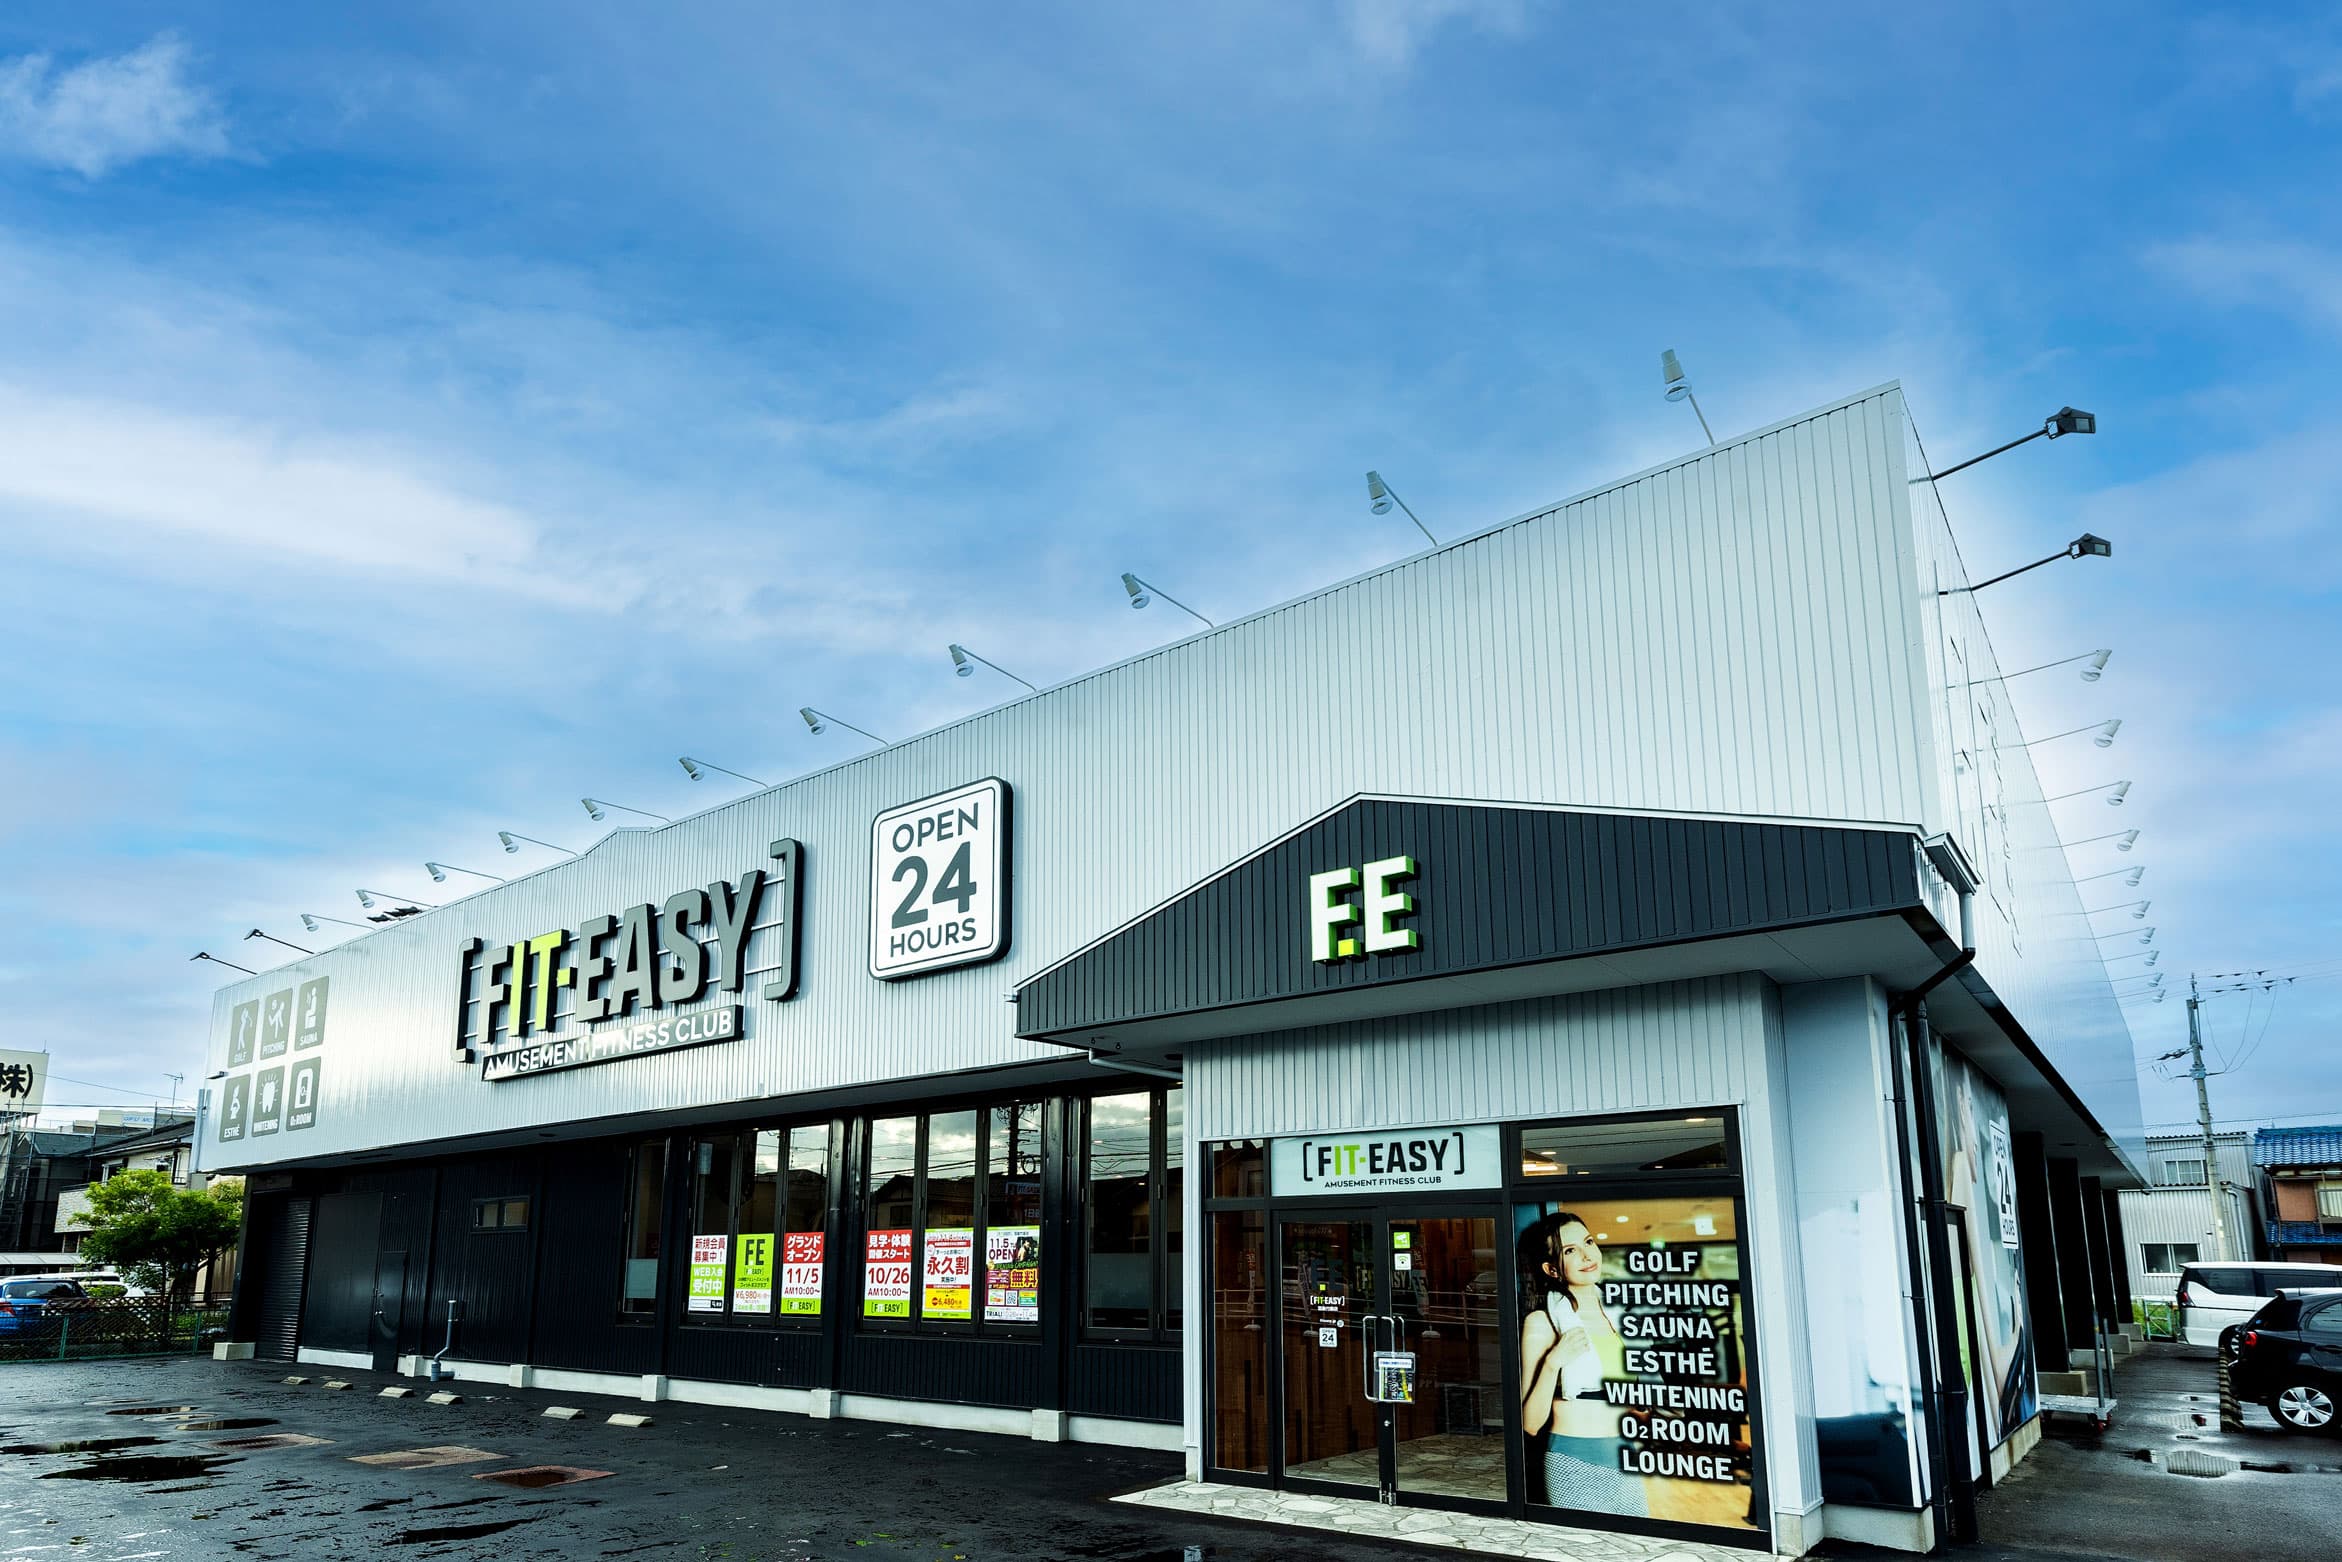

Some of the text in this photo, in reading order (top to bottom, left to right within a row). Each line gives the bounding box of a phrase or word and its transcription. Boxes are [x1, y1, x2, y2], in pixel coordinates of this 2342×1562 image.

[891, 802, 978, 853] OPEN
[891, 841, 978, 929] 24
[889, 916, 977, 959] HOURS
[485, 1008, 733, 1080] AMUSEMENT FITNESS CLUB
[1324, 1176, 1442, 1188] AMUSEMENT FITNESS CLUB
[1997, 1161, 2012, 1215] 24
[787, 1235, 822, 1249] グランド
[786, 1248, 821, 1262] オープン
[927, 1255, 970, 1275] 永久割
[1629, 1250, 1698, 1273] GOLF
[693, 1279, 722, 1294] 受付中
[787, 1268, 819, 1285] 11/5
[868, 1267, 910, 1285] 10/26
[1011, 1269, 1037, 1287] 無料
[1605, 1281, 1730, 1307] PITCHING
[1322, 1333, 1334, 1342] 24
[1623, 1315, 1714, 1339] SAUNA
[1605, 1381, 1745, 1412] WHITENING
[1622, 1449, 1733, 1481] LOUNGE
